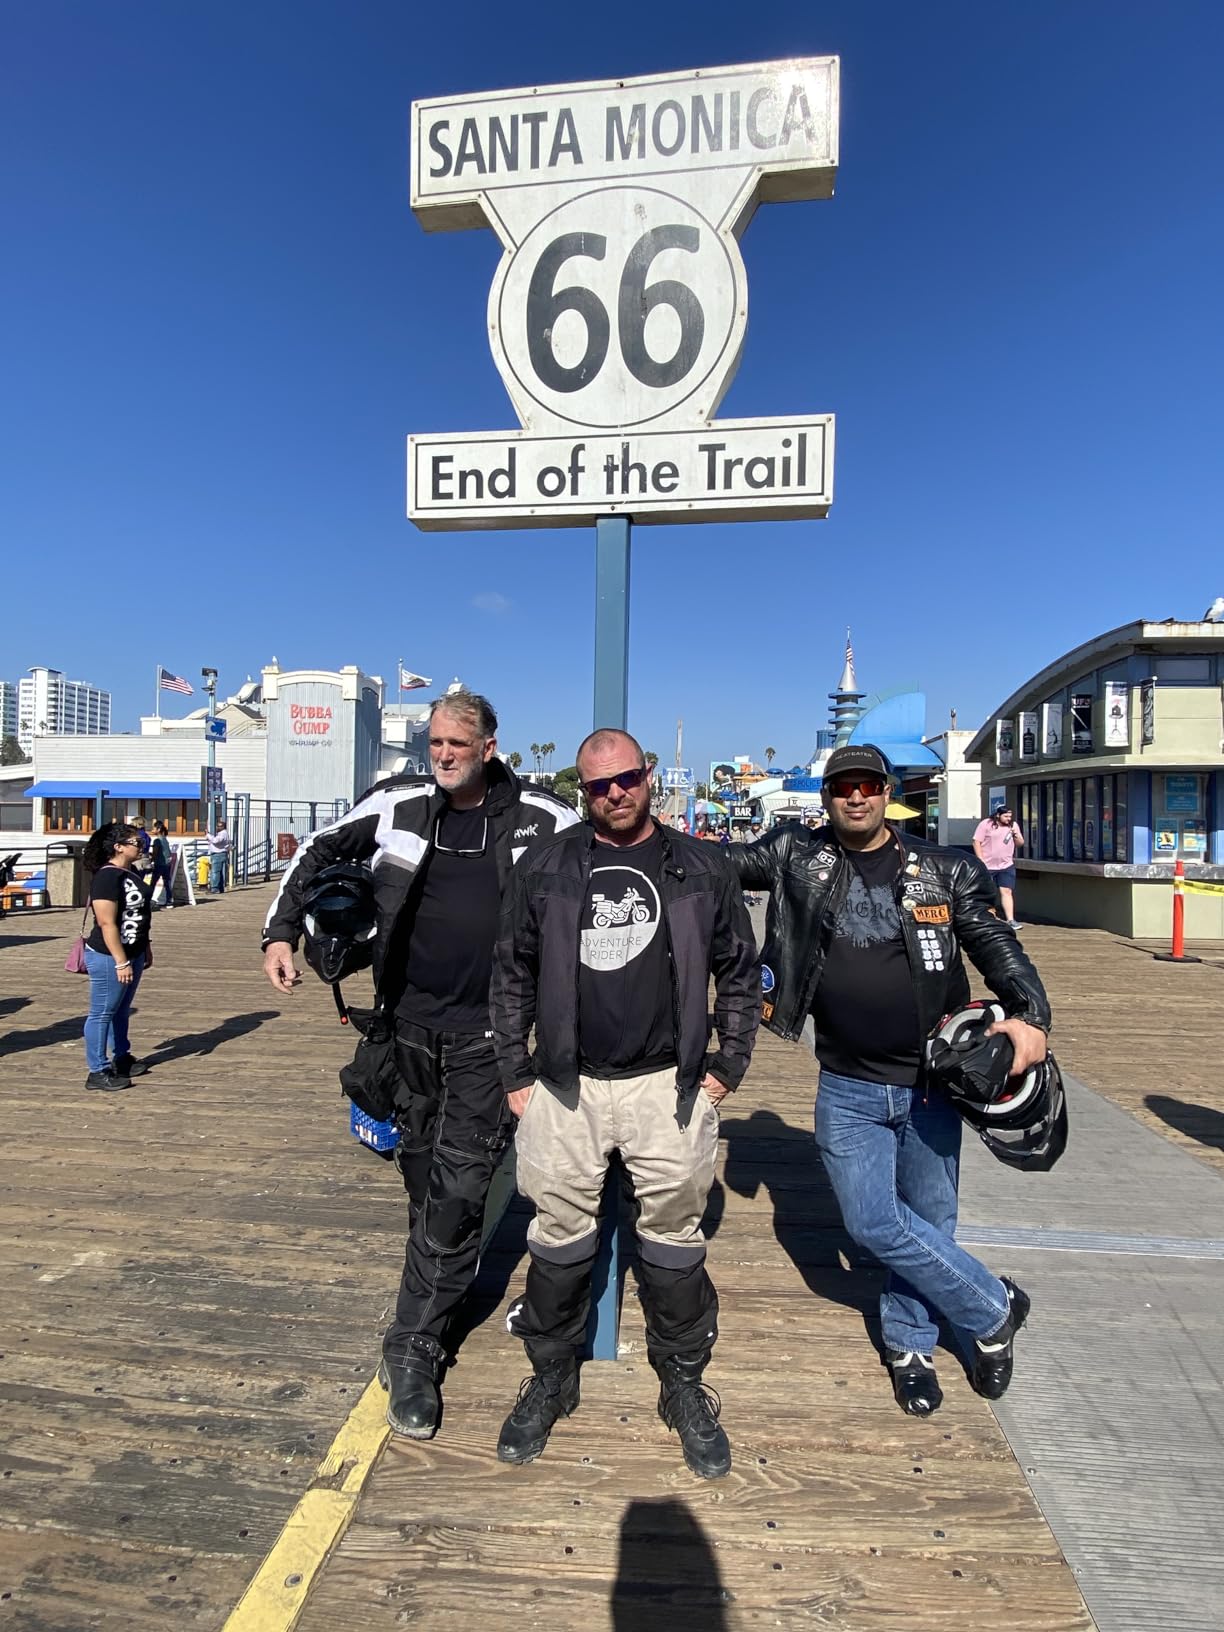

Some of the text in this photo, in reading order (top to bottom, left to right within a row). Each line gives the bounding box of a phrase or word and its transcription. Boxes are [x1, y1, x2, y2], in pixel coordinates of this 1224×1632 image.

[429, 84, 816, 178] SANTA MONICA
[526, 223, 705, 393] 66
[431, 433, 806, 500] End of the Trail
[290, 704, 332, 719] BUBBA
[294, 720, 330, 735] GUMP
[734, 807, 752, 817] BAR
[916, 908, 947, 919] MERC
[590, 950, 623, 960] RIDER
